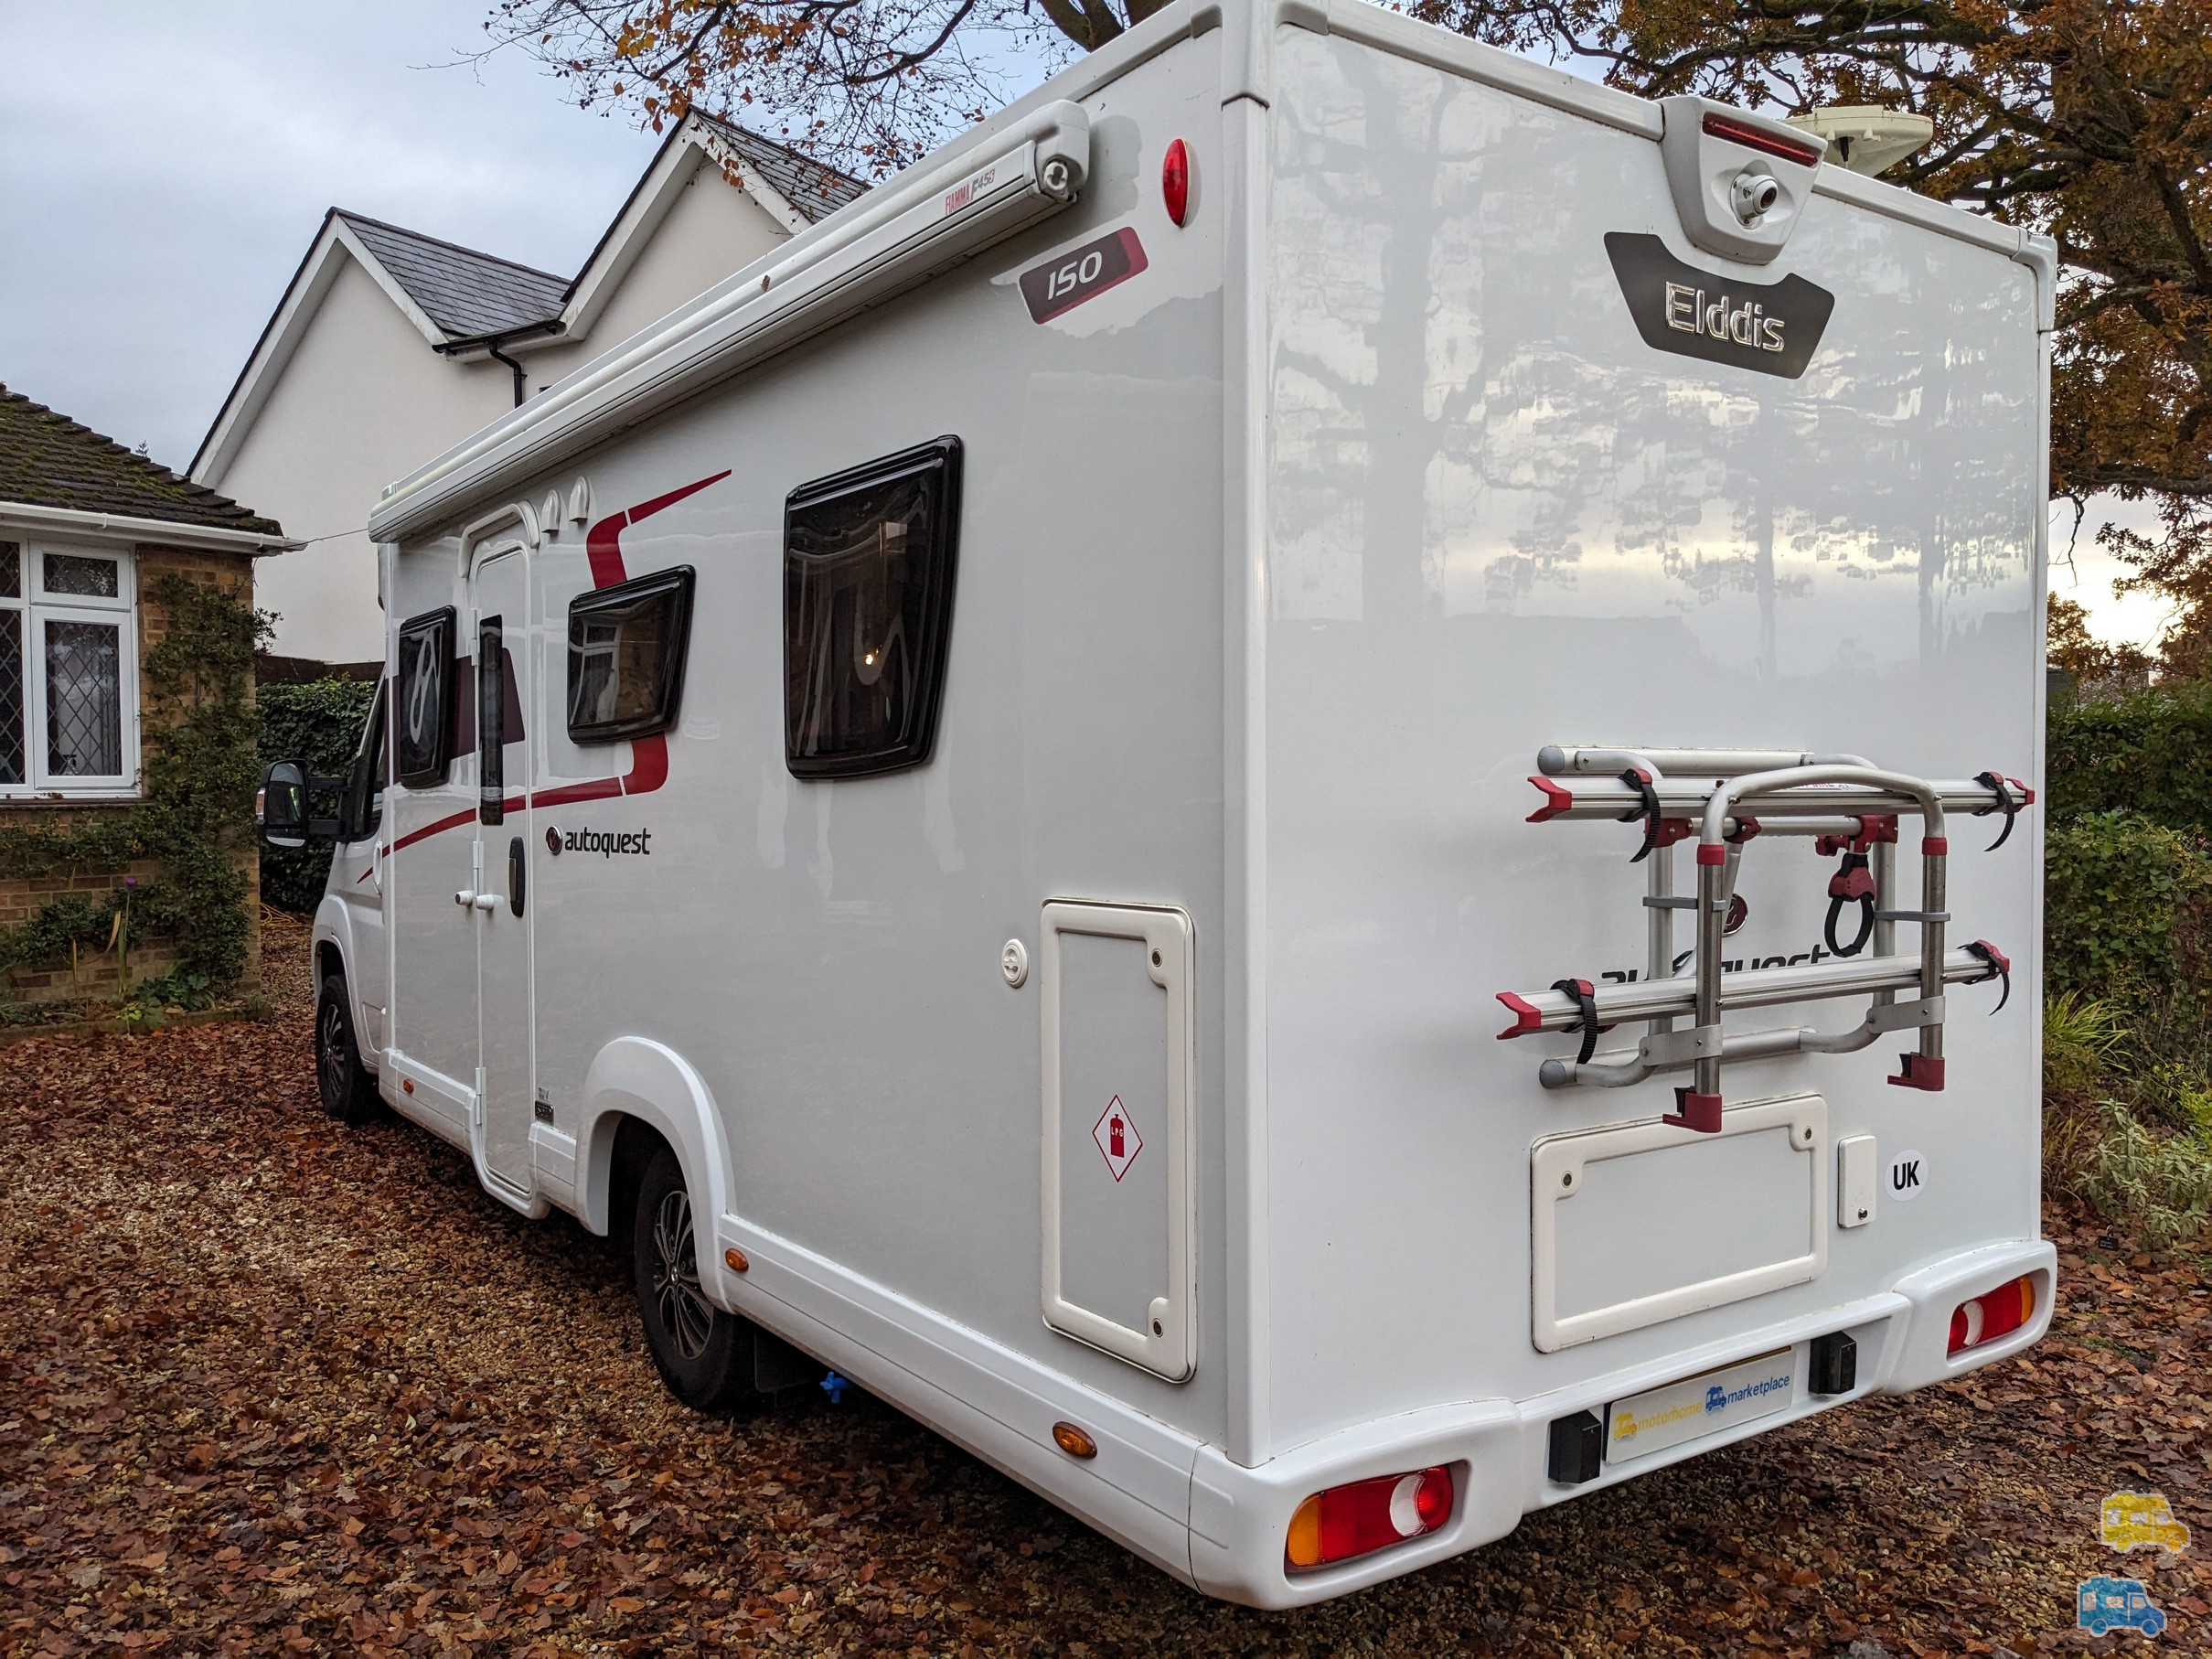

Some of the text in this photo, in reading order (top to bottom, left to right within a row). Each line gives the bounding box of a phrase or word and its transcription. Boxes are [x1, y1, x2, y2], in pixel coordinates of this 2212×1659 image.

[946, 184, 969, 216] FIAMMA
[1048, 252, 1103, 301] 150
[1665, 281, 1785, 353] Elddis
[564, 826, 652, 859] autoquest
[1111, 1127, 1124, 1138] LPG
[1893, 1160, 1920, 1191] UK
[1638, 1375, 1790, 1432] motorhome marketplace
